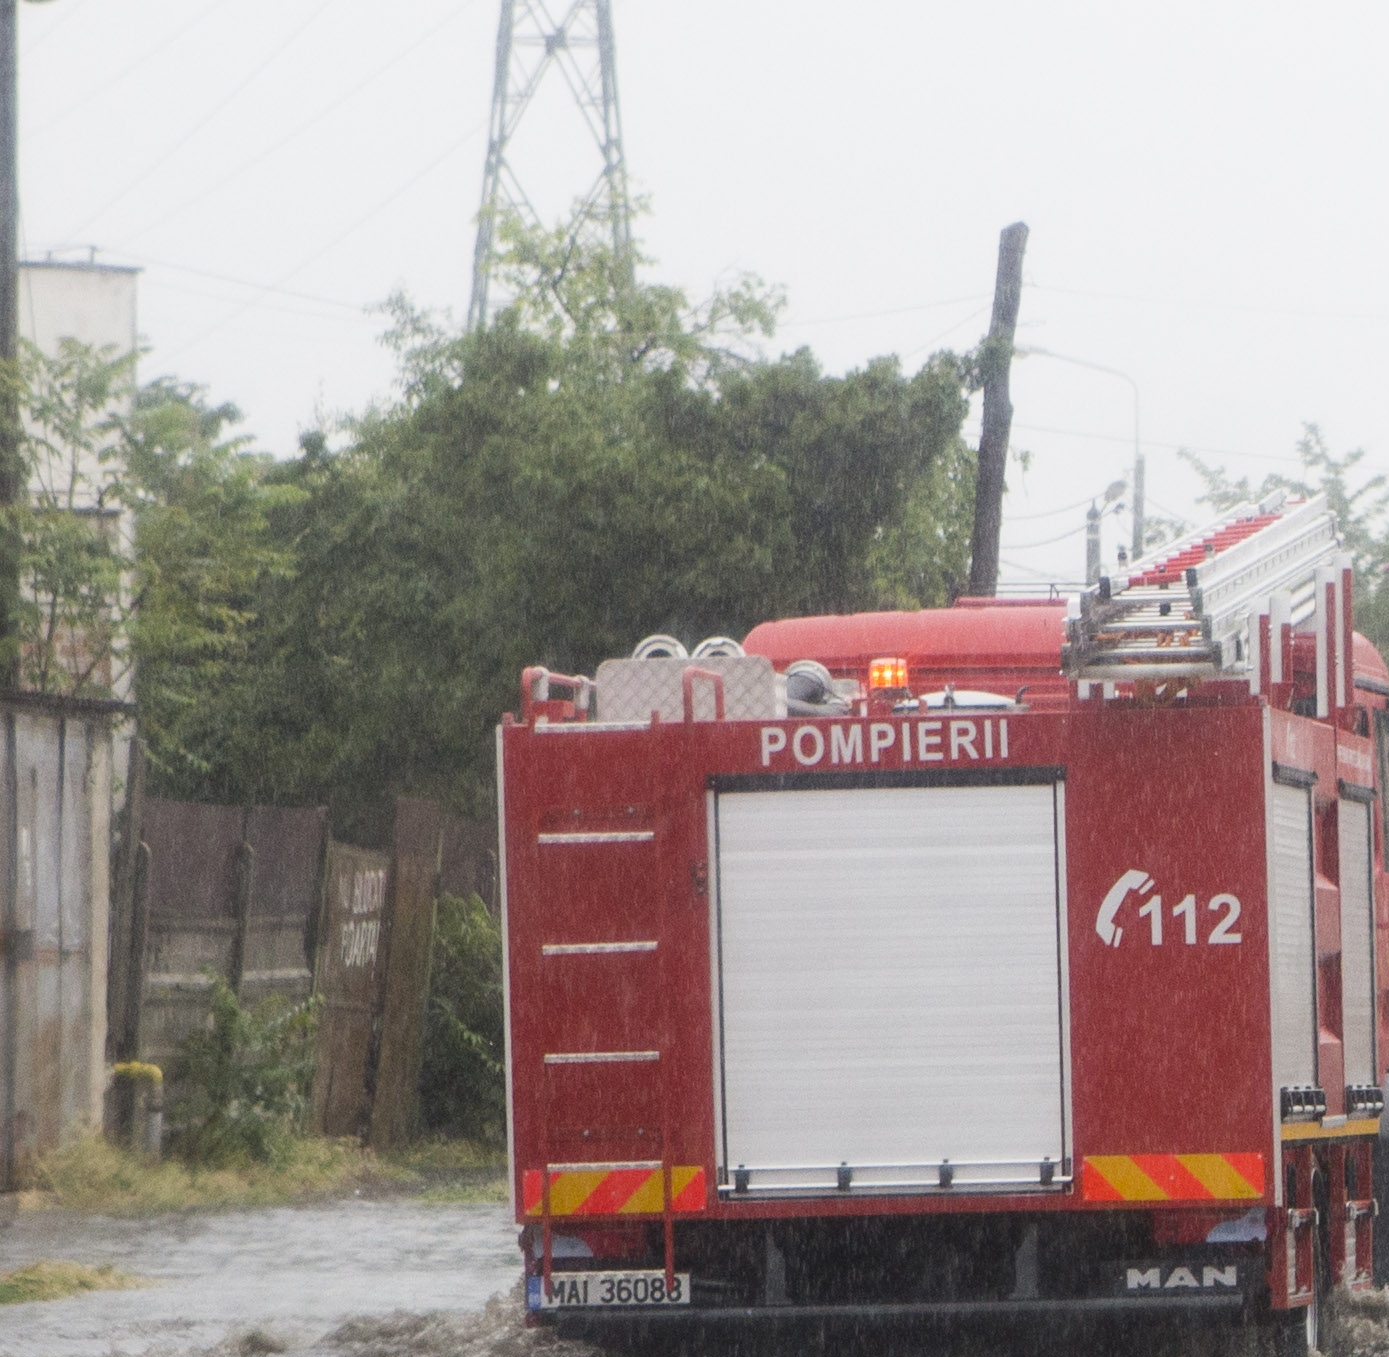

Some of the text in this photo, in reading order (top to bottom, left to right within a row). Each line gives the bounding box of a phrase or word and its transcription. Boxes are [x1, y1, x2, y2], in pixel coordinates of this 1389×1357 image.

[760, 718, 1009, 767] POMPIERII
[1138, 893, 1242, 946] 112
[547, 1279, 588, 1305] MAI
[600, 1278, 682, 1304] 36088
[1126, 1265, 1237, 1289] MAN
